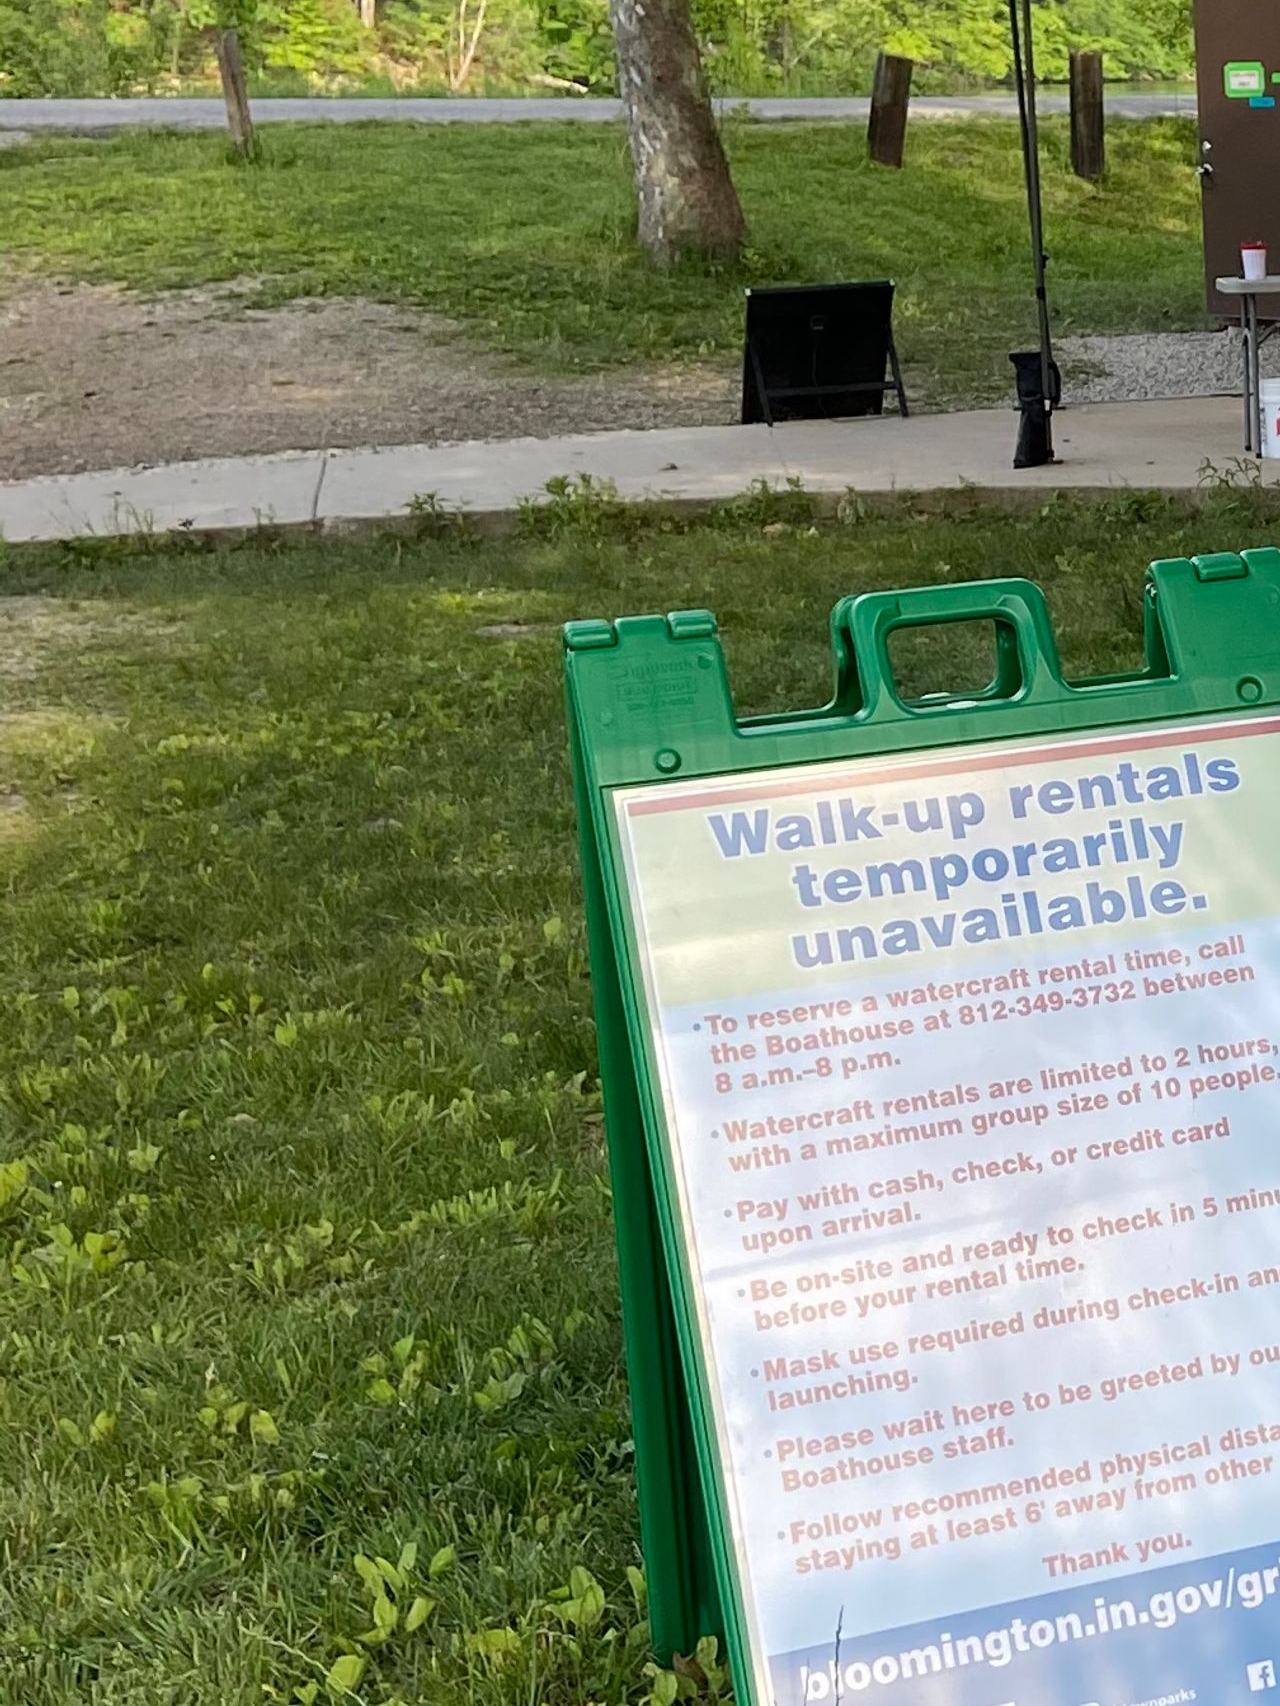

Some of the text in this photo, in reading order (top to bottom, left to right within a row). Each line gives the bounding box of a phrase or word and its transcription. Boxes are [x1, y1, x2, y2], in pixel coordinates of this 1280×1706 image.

[707, 752, 1239, 857] Walk-up rentals
[792, 817, 1183, 907] temporarily
[793, 875, 1207, 968] unavailable.
[703, 934, 1245, 1035] To reserve a watercraft rental time, call
[710, 965, 1254, 1064] the Boathouse at 812-349-3732 between
[715, 1072, 732, 1093] 8
[841, 1051, 901, 1079] p.m.
[722, 1038, 1278, 1142] Watercraft rentals are limited to 2 hours,
[728, 1144, 791, 1172] with
[800, 1143, 816, 1160] a
[826, 1118, 963, 1155] maximum
[971, 1103, 1049, 1136] group
[1057, 1092, 1108, 1116] size
[1117, 1082, 1141, 1105] of
[1150, 1077, 1181, 1099] 10
[736, 1116, 1230, 1222] Pay with cash, check, or credit card
[742, 1201, 921, 1254] upon arrival.
[750, 1279, 787, 1301] Be
[796, 1259, 892, 1292] on-site
[902, 1244, 954, 1273] and
[962, 1231, 1038, 1262] ready
[1046, 1226, 1074, 1246] to
[1082, 1207, 1163, 1240] check
[1169, 1202, 1195, 1226] in
[1202, 1197, 1218, 1217] 5
[754, 1256, 1085, 1331] before your rental time.
[762, 1349, 840, 1382] Mask
[848, 1341, 899, 1365] use
[907, 1311, 1024, 1353] required
[1033, 1298, 1120, 1329] during
[1127, 1272, 1239, 1310] check-in
[768, 1369, 918, 1412] launching.
[776, 1428, 874, 1462] Please
[882, 1410, 945, 1440] wait
[952, 1400, 1015, 1427] here
[1022, 1391, 1050, 1411] to
[1058, 1384, 1091, 1405] be
[1100, 1356, 1203, 1401] greeted
[1210, 1353, 1240, 1376] by
[781, 1425, 1014, 1492] Boathouse staff.
[790, 1509, 882, 1544] Follow
[892, 1460, 1091, 1522] recommended
[1099, 1435, 1211, 1484] physical
[795, 1536, 901, 1574] staying
[910, 1524, 938, 1549] at
[946, 1507, 1018, 1541] least
[1055, 1486, 1126, 1518] away
[1133, 1472, 1197, 1500] from
[1204, 1456, 1273, 1484] other
[1042, 1532, 1192, 1577] Thank you.
